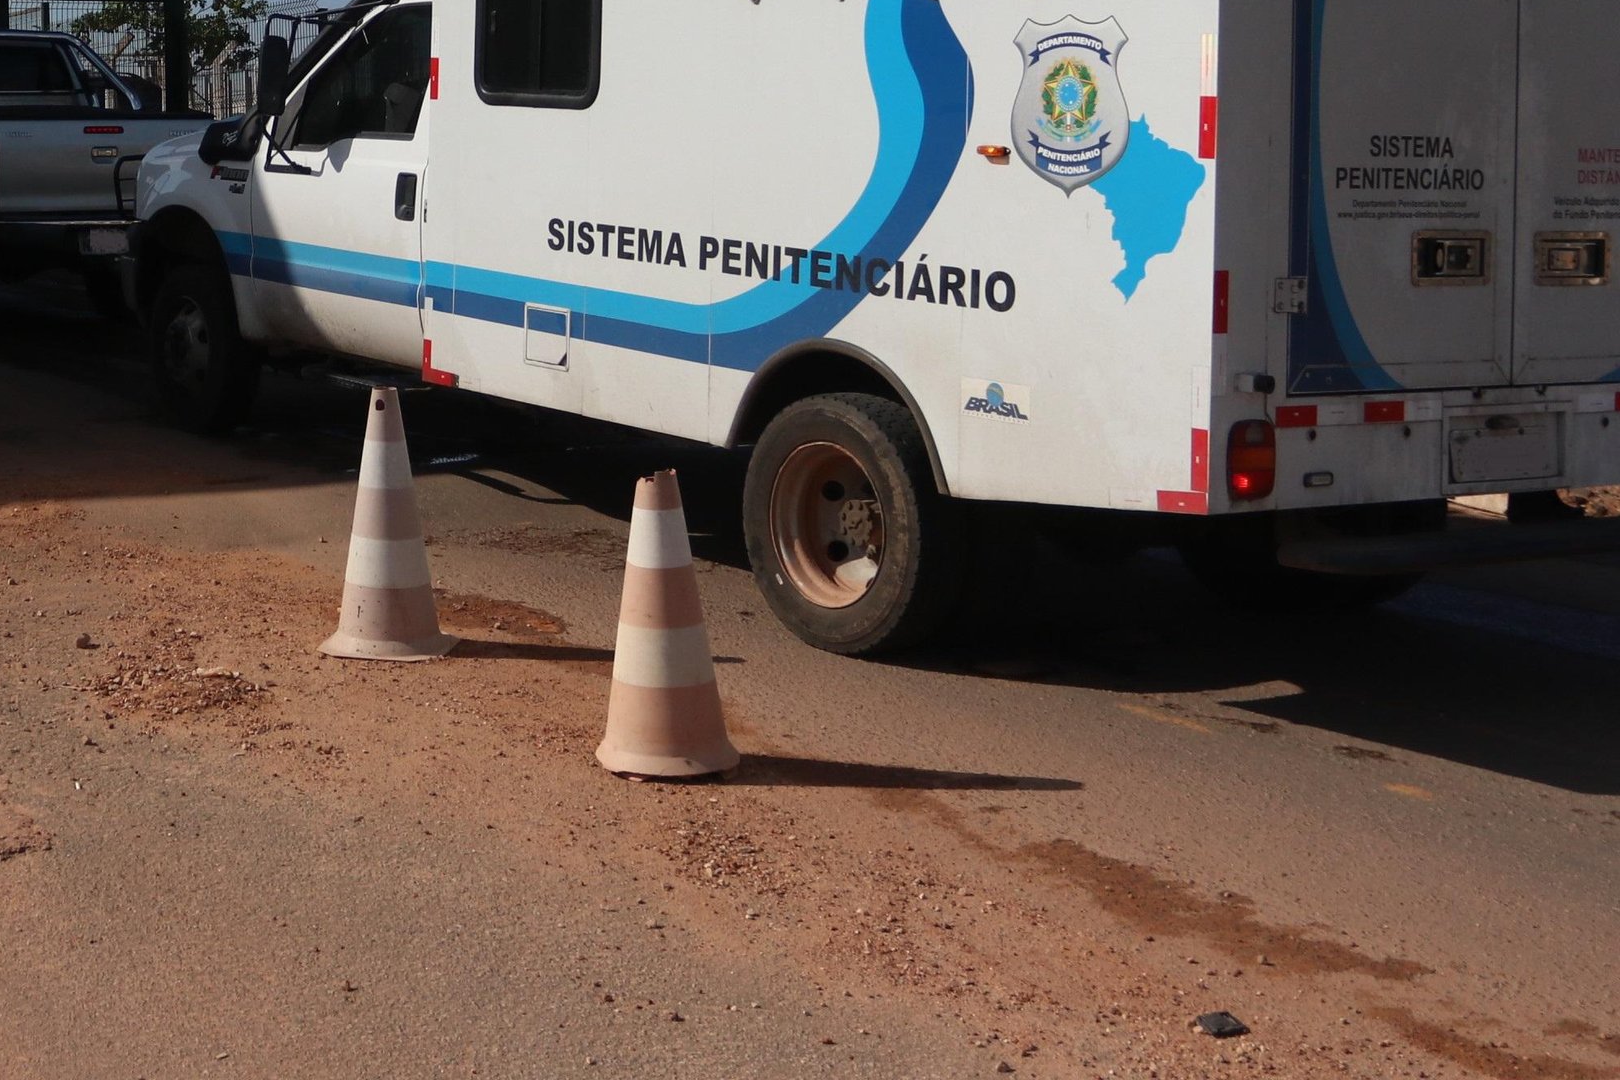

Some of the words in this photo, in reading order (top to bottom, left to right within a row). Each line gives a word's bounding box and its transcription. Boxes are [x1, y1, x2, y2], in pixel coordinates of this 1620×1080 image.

[1037, 35, 1103, 52] DEPARTAMENTO
[1037, 146, 1101, 163] PENITENCIÁRIO
[1369, 135, 1454, 158] SISTEMA
[1047, 162, 1090, 175] NACIONAL
[1335, 163, 1485, 191] PENITENCIÁRIO
[547, 217, 687, 268] SISTEMA
[698, 235, 1017, 313] PENITENCIÁRIO
[963, 396, 1029, 421] BRASIL
